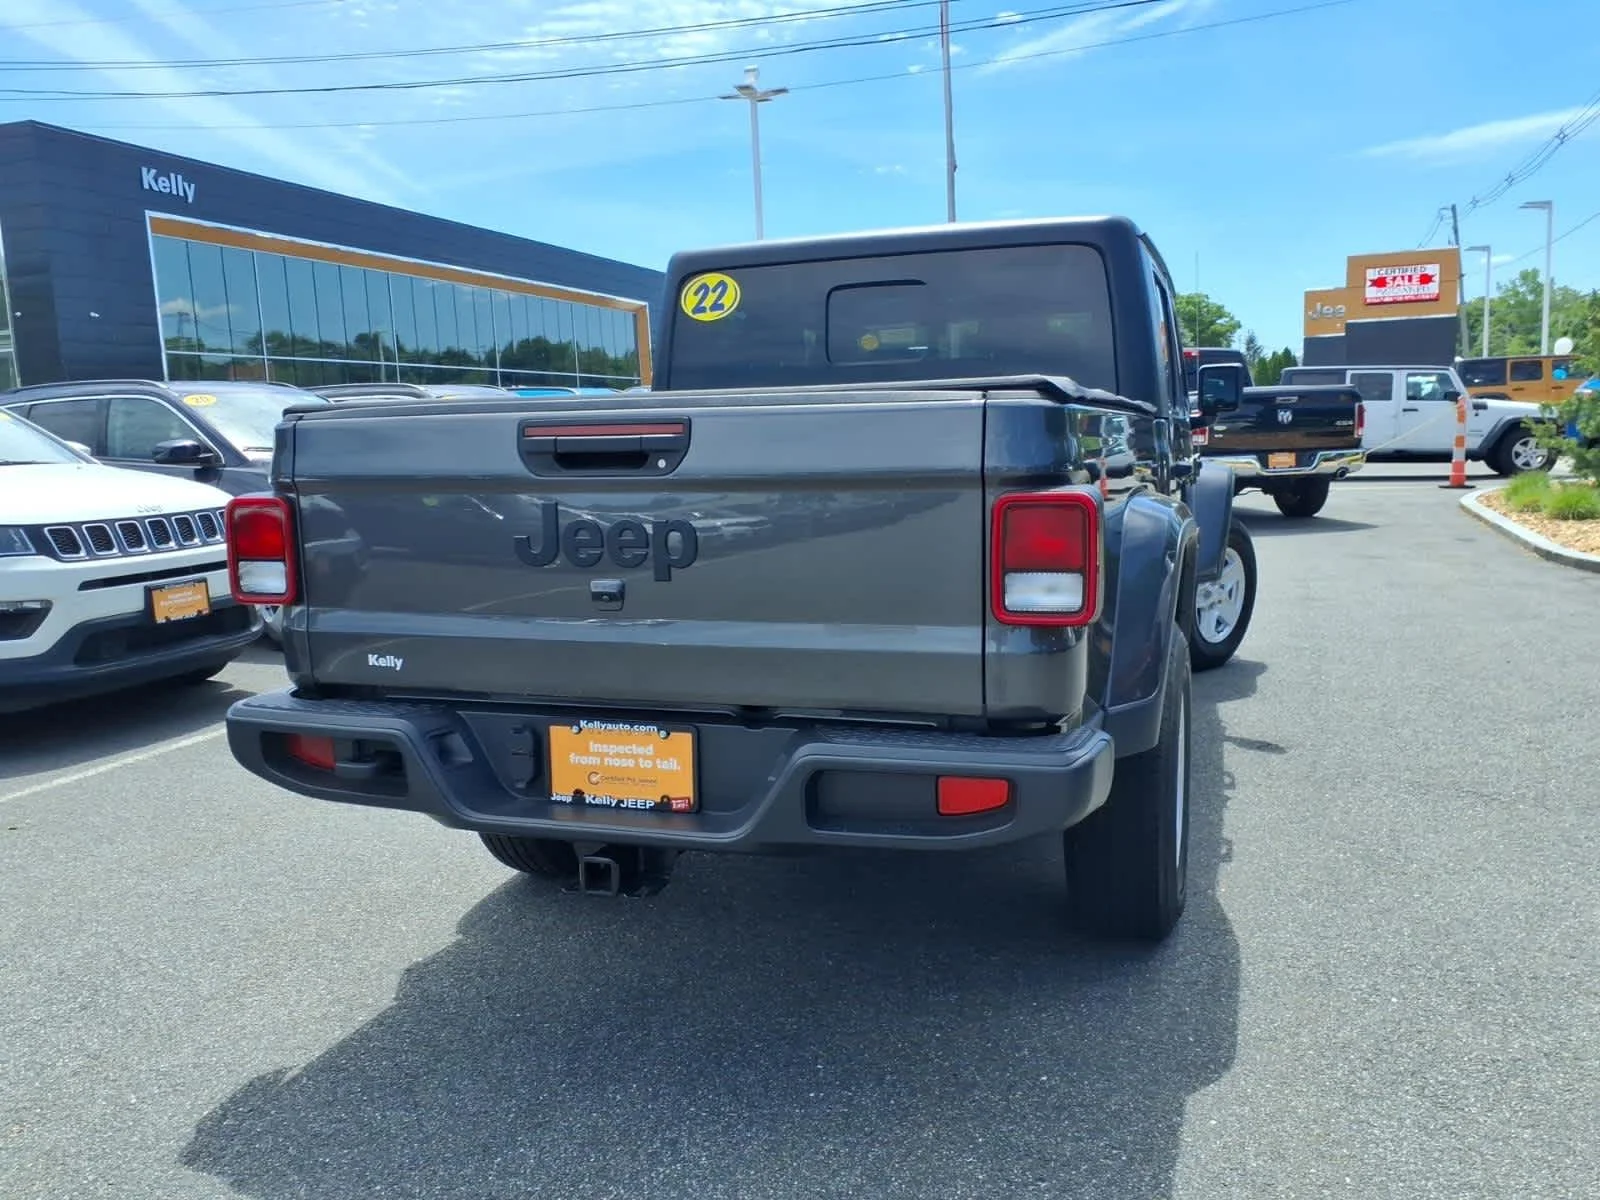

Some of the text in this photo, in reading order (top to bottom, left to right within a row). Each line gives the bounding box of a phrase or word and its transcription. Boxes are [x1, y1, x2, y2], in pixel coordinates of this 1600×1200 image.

[141, 166, 195, 203] Kelly
[1376, 265, 1427, 276] CERTIFIED
[1386, 273, 1421, 289] SALE
[692, 280, 728, 315] 22
[1308, 302, 1346, 320] Jee
[513, 502, 698, 582] Jeep
[367, 653, 404, 671] Kelly
[580, 719, 658, 733] Kellyauto.com
[589, 741, 655, 756] Inspected
[569, 752, 681, 771] from nose to tail.
[551, 792, 573, 803] Jeep
[585, 794, 656, 809] Kelly JEEP
